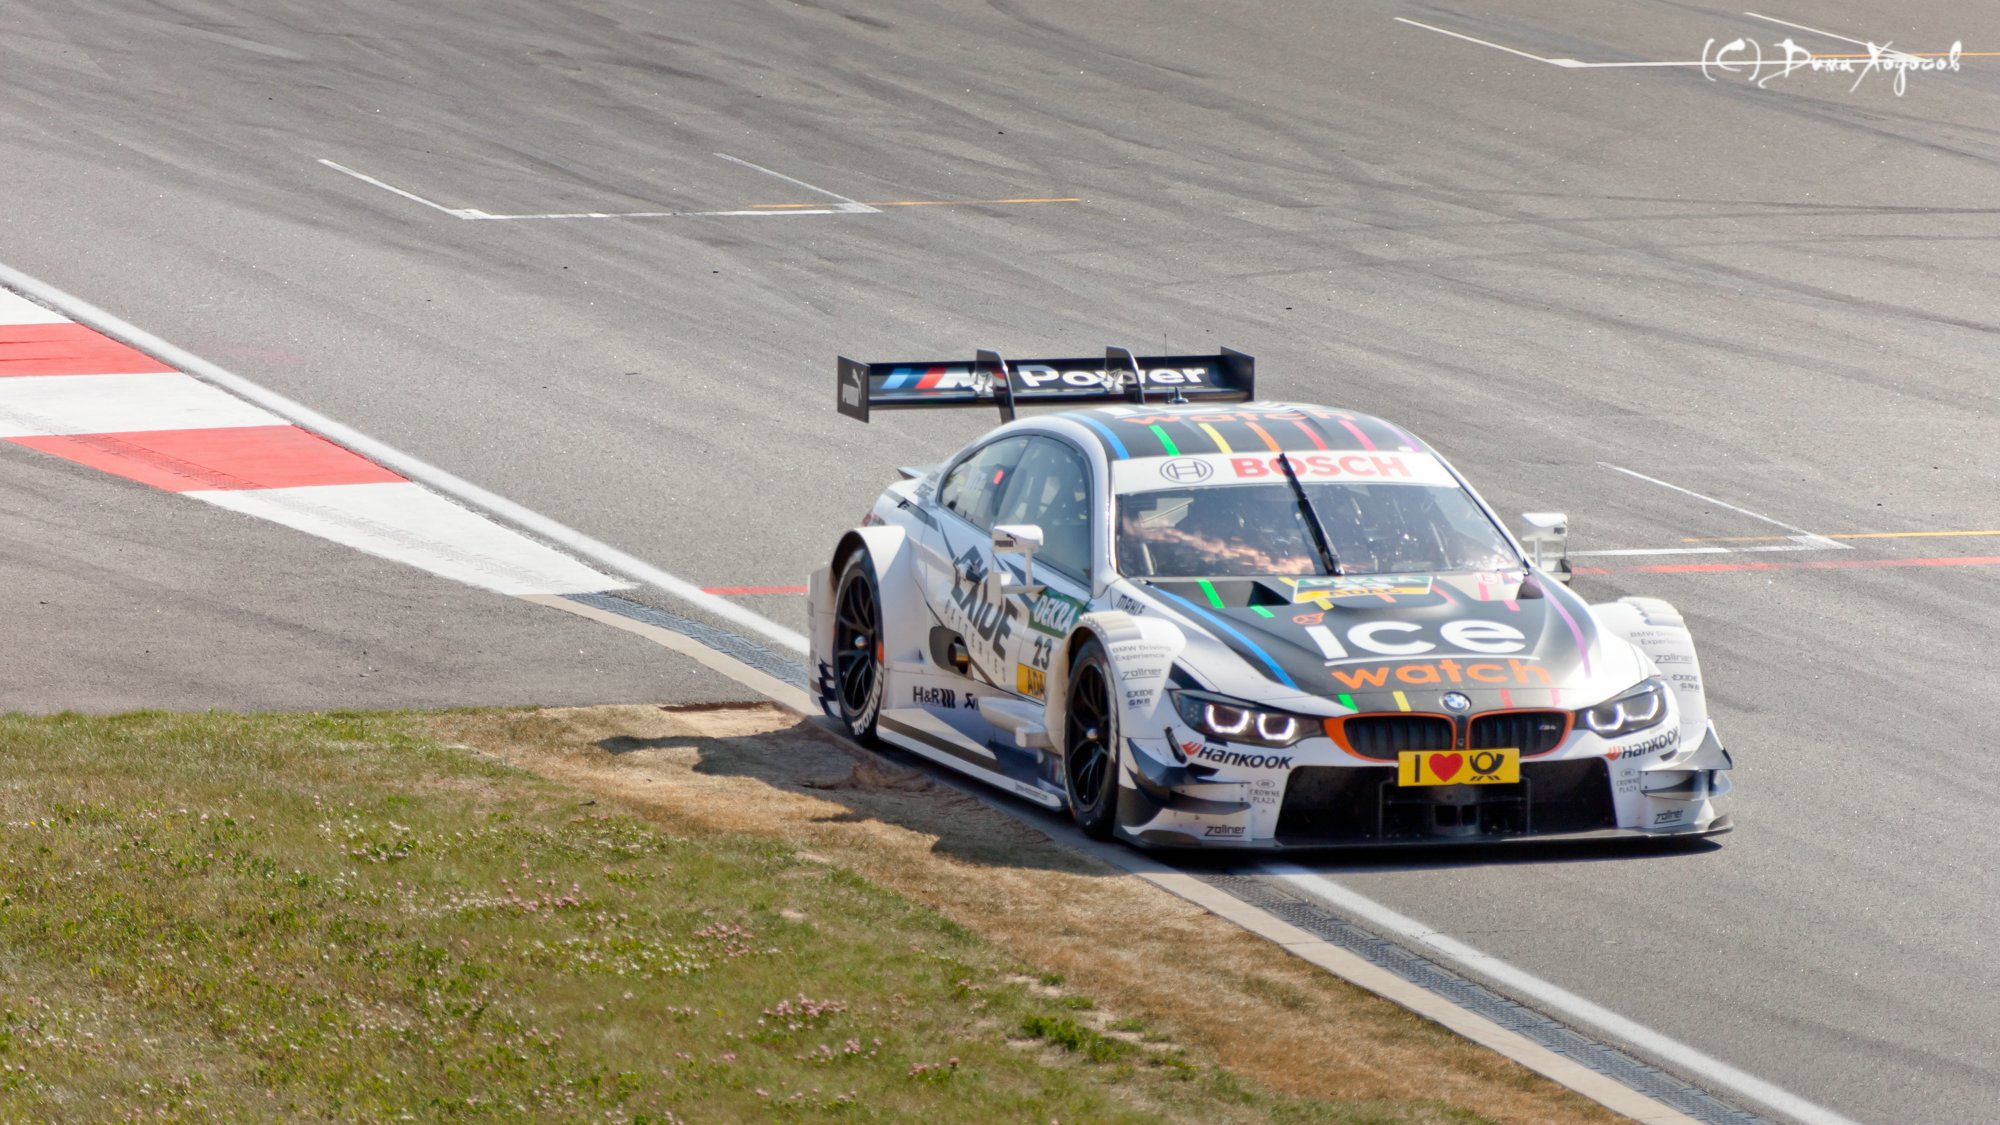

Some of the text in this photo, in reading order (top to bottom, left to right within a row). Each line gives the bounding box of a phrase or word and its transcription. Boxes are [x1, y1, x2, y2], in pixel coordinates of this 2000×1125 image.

[1230, 456, 1412, 479] BOSCH
[1033, 595, 1078, 632] DEKRA
[1032, 635, 1053, 670] 23
[1115, 652, 1165, 661] Experience
[1331, 658, 1554, 690] watch
[913, 686, 940, 704] H&R
[1414, 754, 1421, 783] I
[1250, 789, 1280, 797] CROWNE
[1252, 796, 1276, 804] PLAZA
